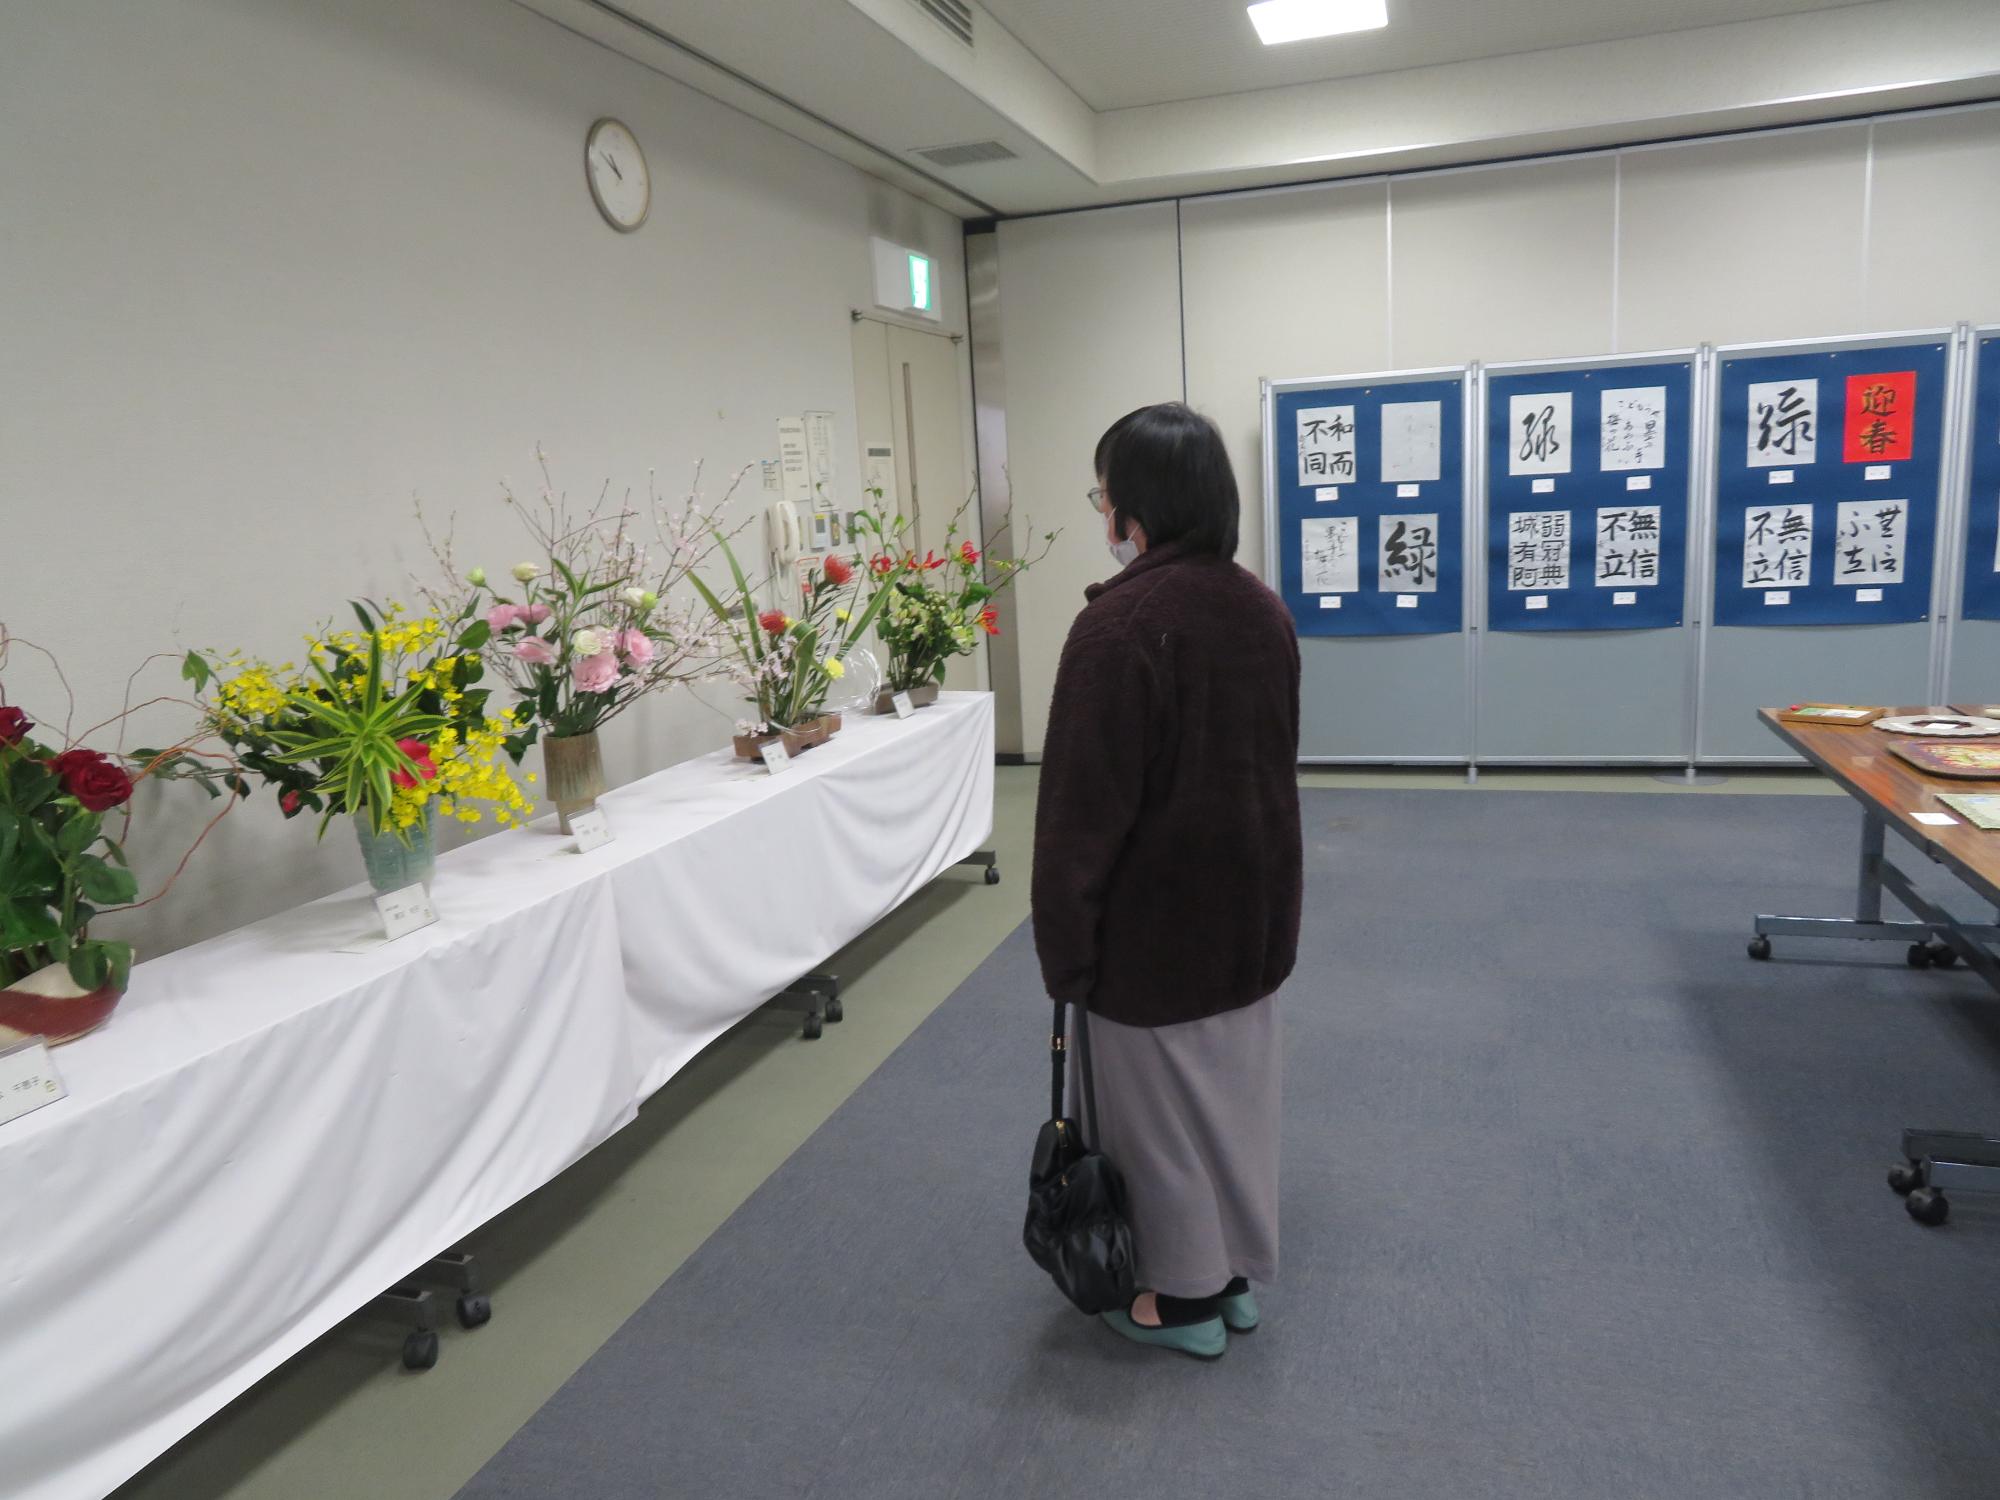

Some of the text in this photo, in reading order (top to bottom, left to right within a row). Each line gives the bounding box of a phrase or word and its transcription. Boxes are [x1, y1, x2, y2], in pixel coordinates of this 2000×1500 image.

[1302, 420, 1328, 475] 不同
[1327, 414, 1354, 476] 和而
[1860, 385, 1898, 454] 迎春
[1599, 512, 1627, 579] 不立
[1628, 510, 1658, 579] 無信
[1748, 511, 1776, 583] 不立
[1775, 508, 1810, 581] 無信
